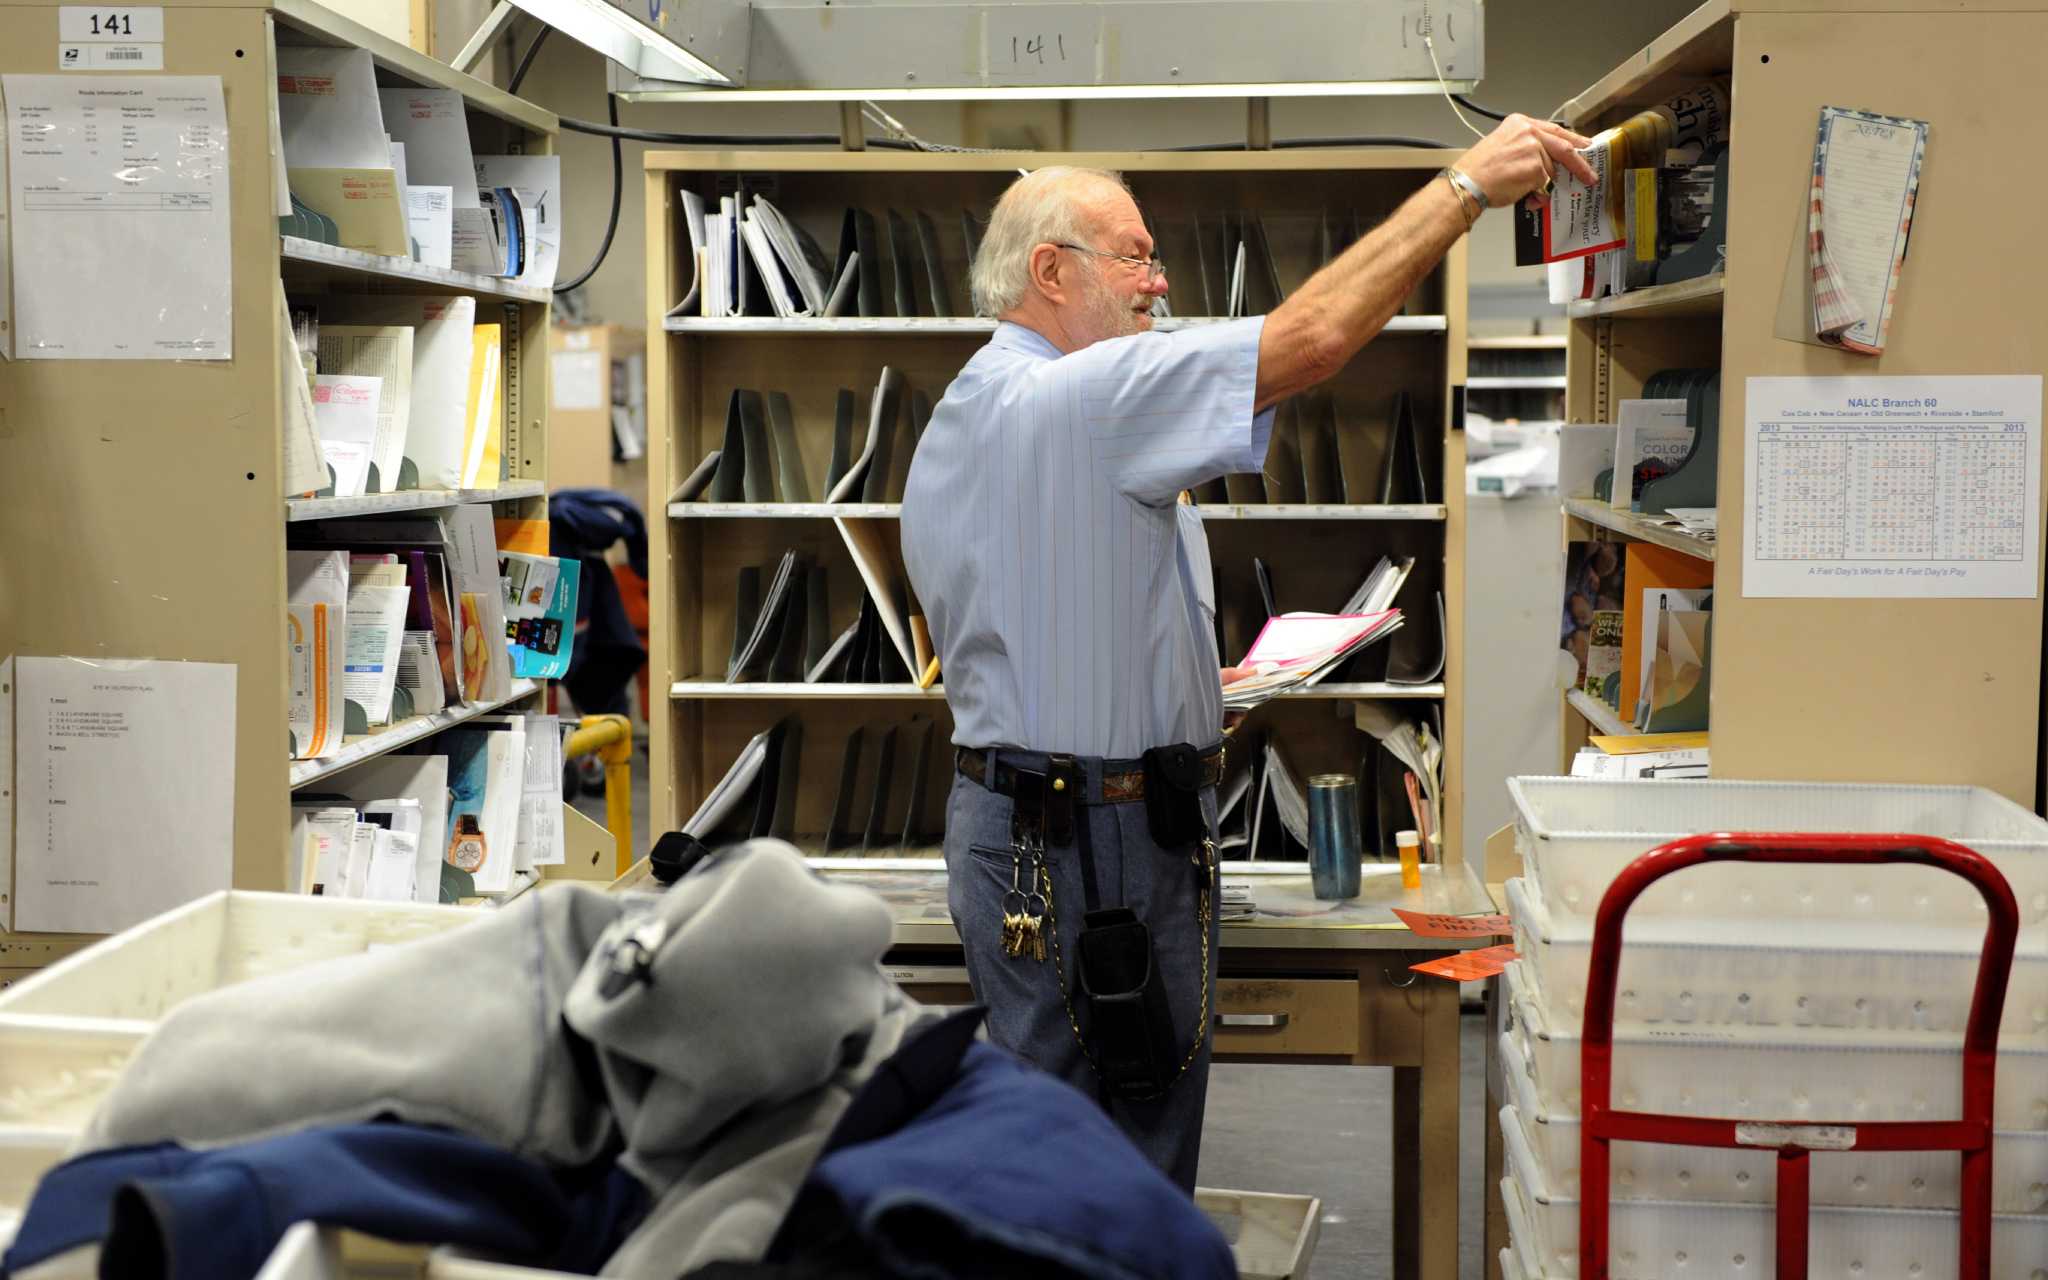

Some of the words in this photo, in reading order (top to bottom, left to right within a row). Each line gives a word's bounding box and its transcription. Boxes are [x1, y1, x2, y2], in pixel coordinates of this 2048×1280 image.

[90, 14, 132, 35] 141
[1012, 33, 1065, 64] 141
[1848, 398, 1879, 408] NALC
[1882, 398, 1921, 408] Branch
[1924, 398, 1937, 408] 60
[1760, 424, 1781, 432] 2013
[2004, 424, 2025, 432] 2013
[1642, 444, 1689, 454] COLOR
[1808, 567, 1816, 576] A
[1860, 567, 1882, 576] Work
[1897, 567, 1905, 576] A
[1950, 567, 1967, 577] Pay
